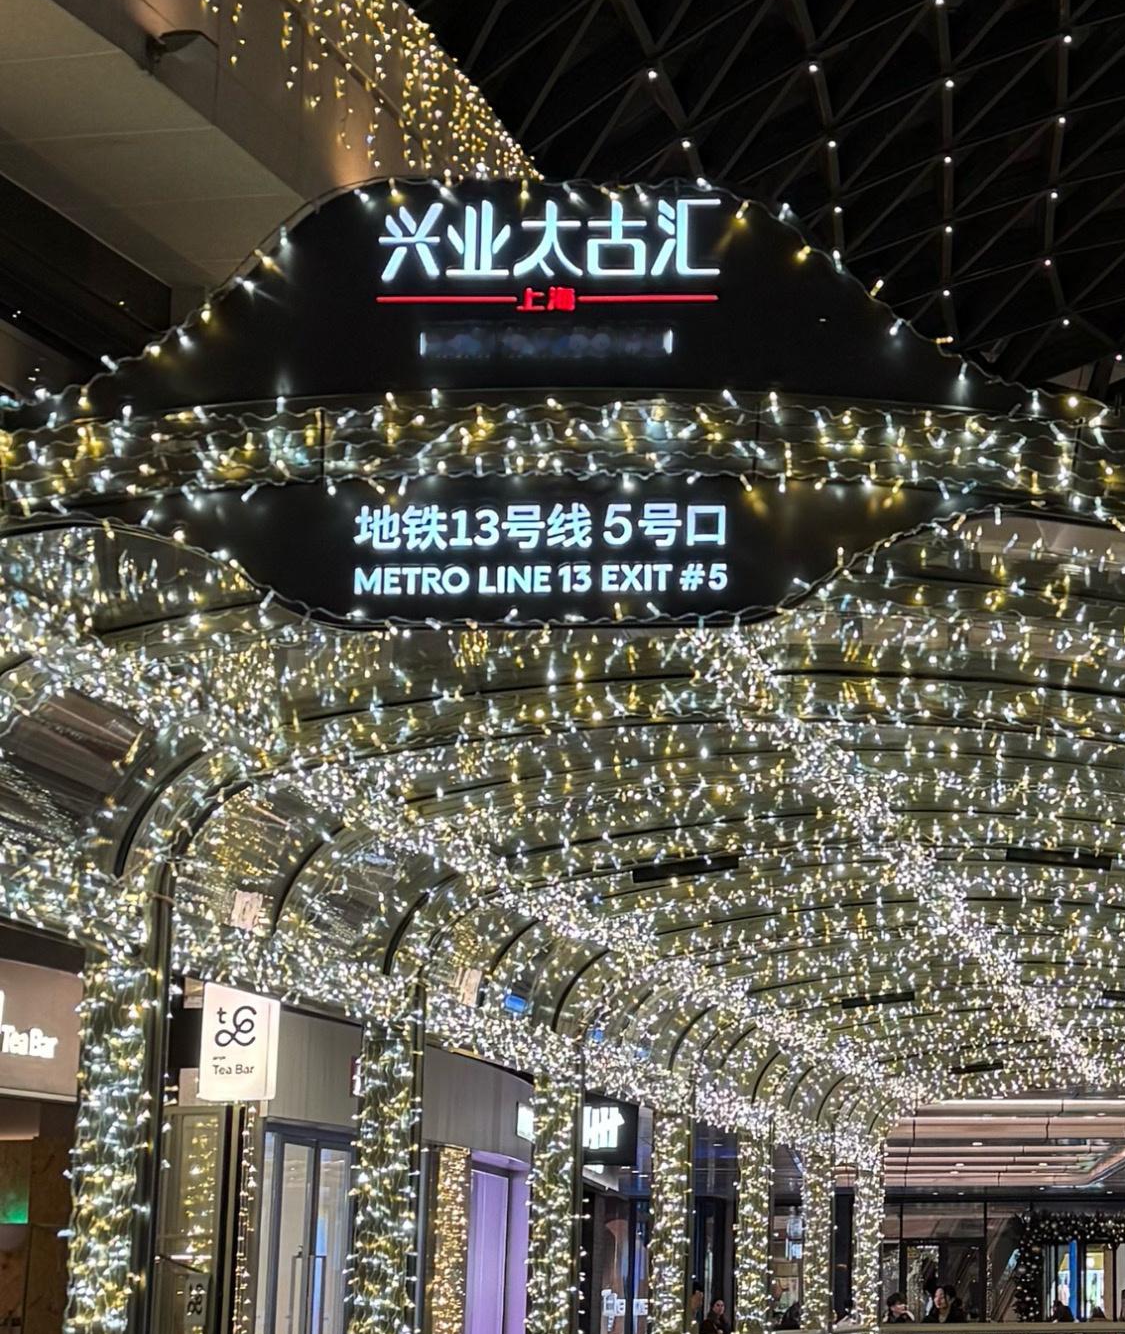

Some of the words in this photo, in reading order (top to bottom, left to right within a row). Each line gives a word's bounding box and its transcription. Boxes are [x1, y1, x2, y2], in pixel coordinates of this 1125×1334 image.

[379, 198, 721, 281] 兴业太古汇
[516, 286, 576, 312] 上海
[353, 567, 471, 596] METRO
[477, 565, 553, 594] LINE
[557, 564, 593, 593] 13
[600, 563, 674, 592] EXIT
[678, 562, 728, 591] #5
[2, 1024, 28, 1055] Tea
[29, 1027, 58, 1058] Bar
[212, 1064, 232, 1075] Tea
[235, 1063, 255, 1075] Bar
